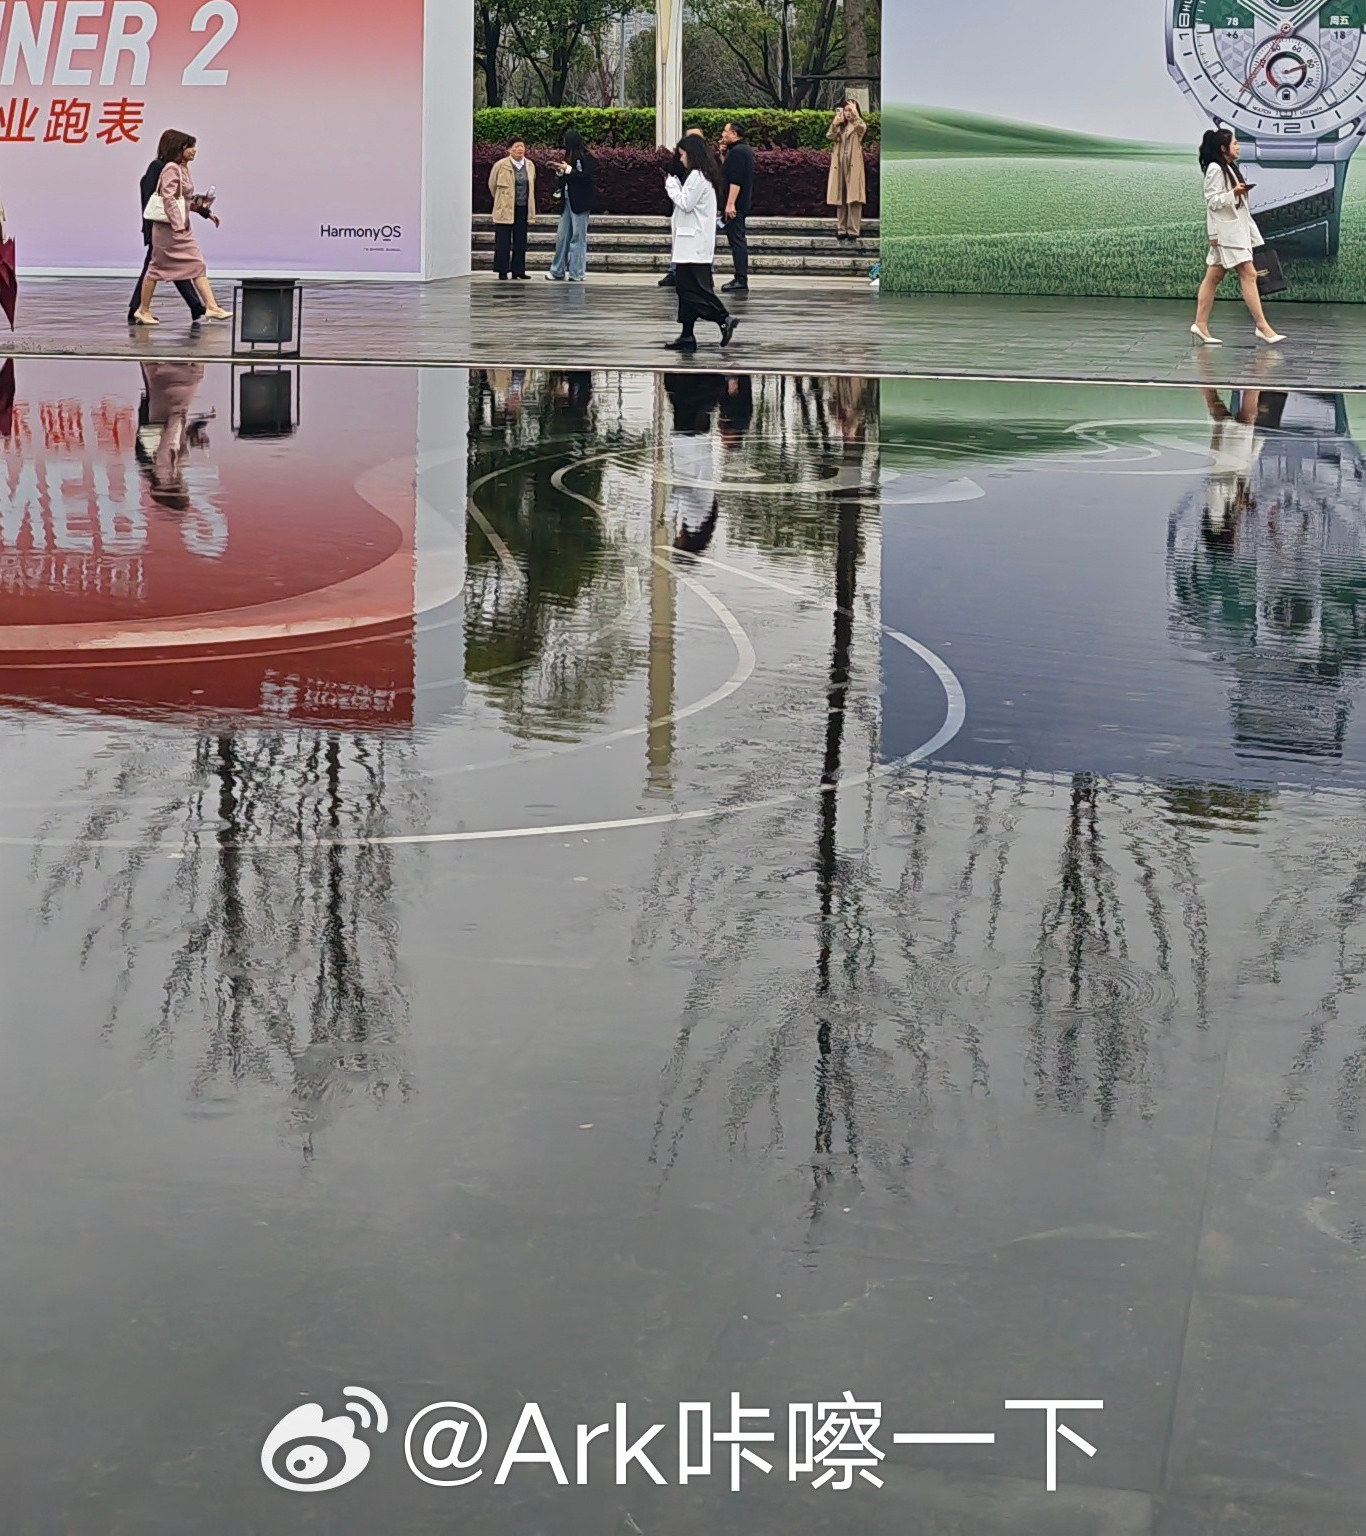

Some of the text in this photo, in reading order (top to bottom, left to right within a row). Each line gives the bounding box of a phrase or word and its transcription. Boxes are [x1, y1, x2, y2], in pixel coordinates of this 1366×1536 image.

[1226, 16, 1239, 26] 78
[1333, 31, 1346, 40] 18
[181, 0, 239, 87] 2
[1272, 122, 1301, 134] 12
[320, 224, 402, 242] HarmonyOS
